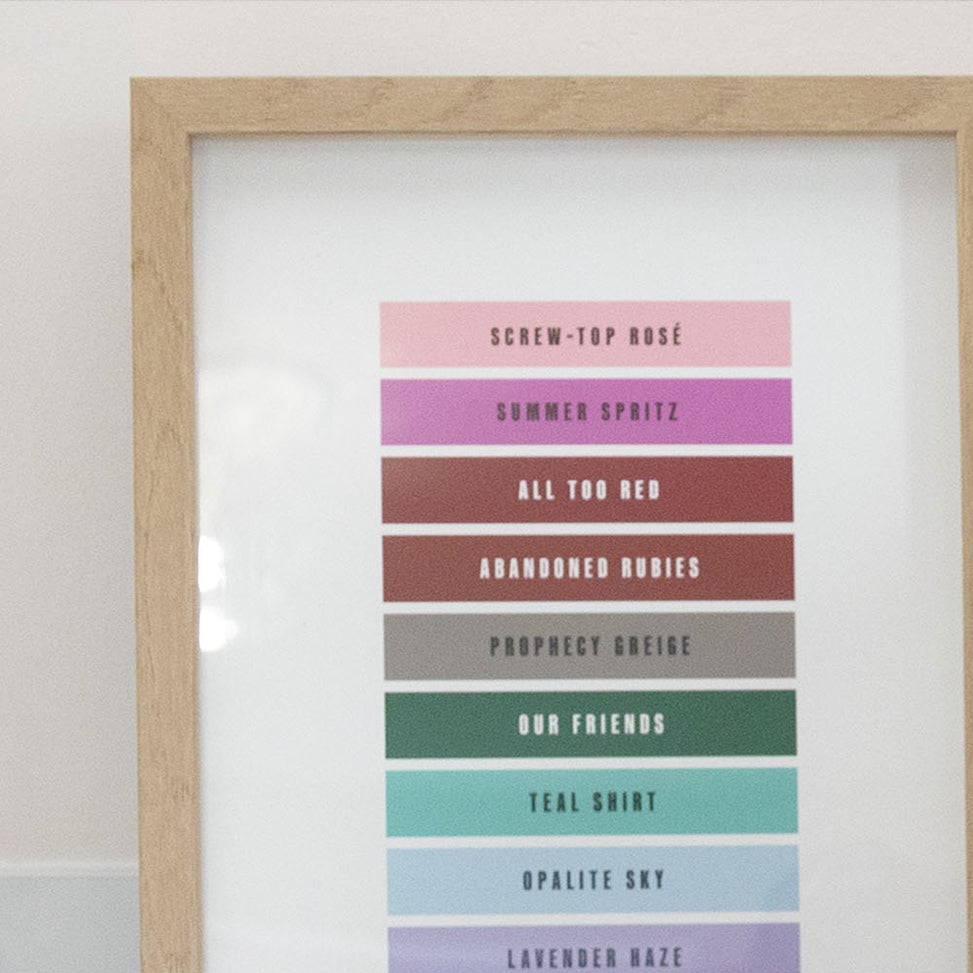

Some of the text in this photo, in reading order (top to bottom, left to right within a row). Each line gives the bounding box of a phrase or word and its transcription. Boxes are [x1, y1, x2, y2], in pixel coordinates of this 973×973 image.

[490, 322, 681, 347] SCREW-TOP ROSÉ
[496, 401, 678, 422] SUMMER SPRITZ
[518, 479, 660, 501] ALL TOO RED
[479, 556, 700, 580] ABANDONED RUBIES
[489, 635, 690, 657] PROPHECY GREIGE
[518, 712, 665, 736] OUR FRIENDS
[529, 791, 656, 813] TEAL SHIRT
[522, 869, 664, 891] OPALITE SKY
[507, 946, 682, 970] LAVENDER HAZE
